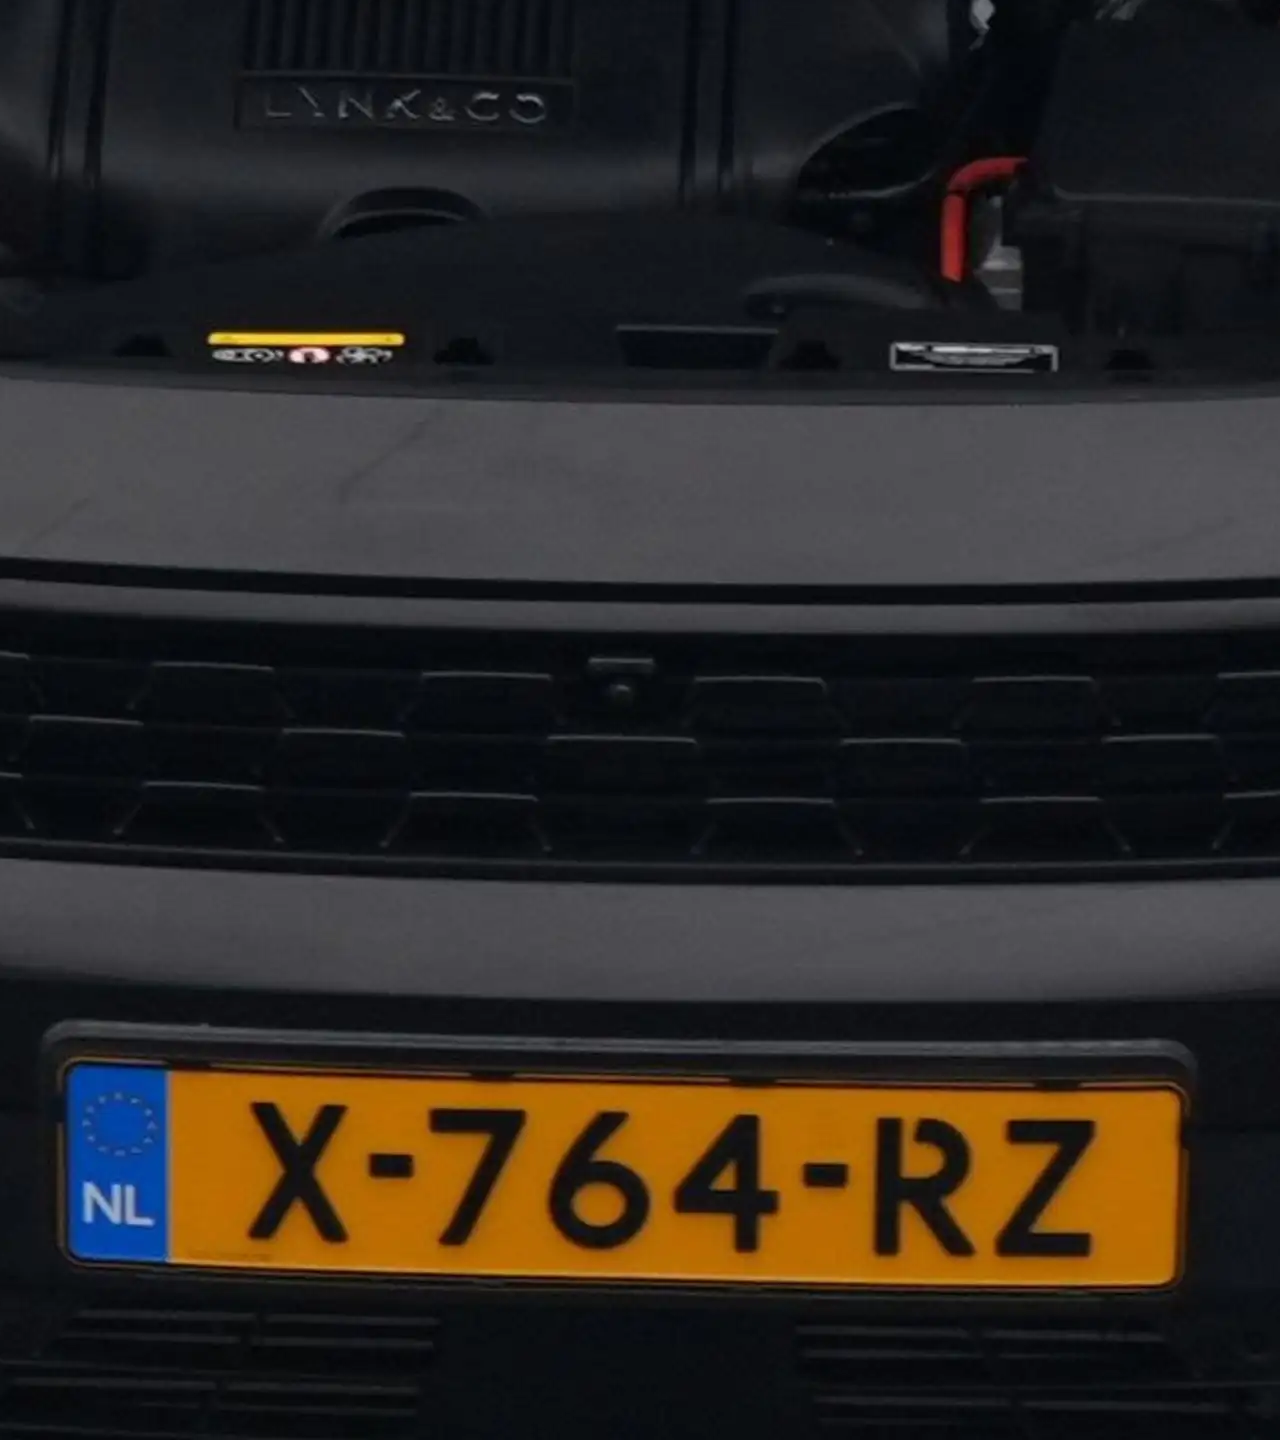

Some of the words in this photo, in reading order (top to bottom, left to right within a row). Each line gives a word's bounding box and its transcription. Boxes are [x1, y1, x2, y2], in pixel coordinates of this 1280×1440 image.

[264, 84, 548, 125] LYNK&CO
[248, 1101, 1096, 1258] X-764-RZ
[81, 1181, 155, 1229] NL
